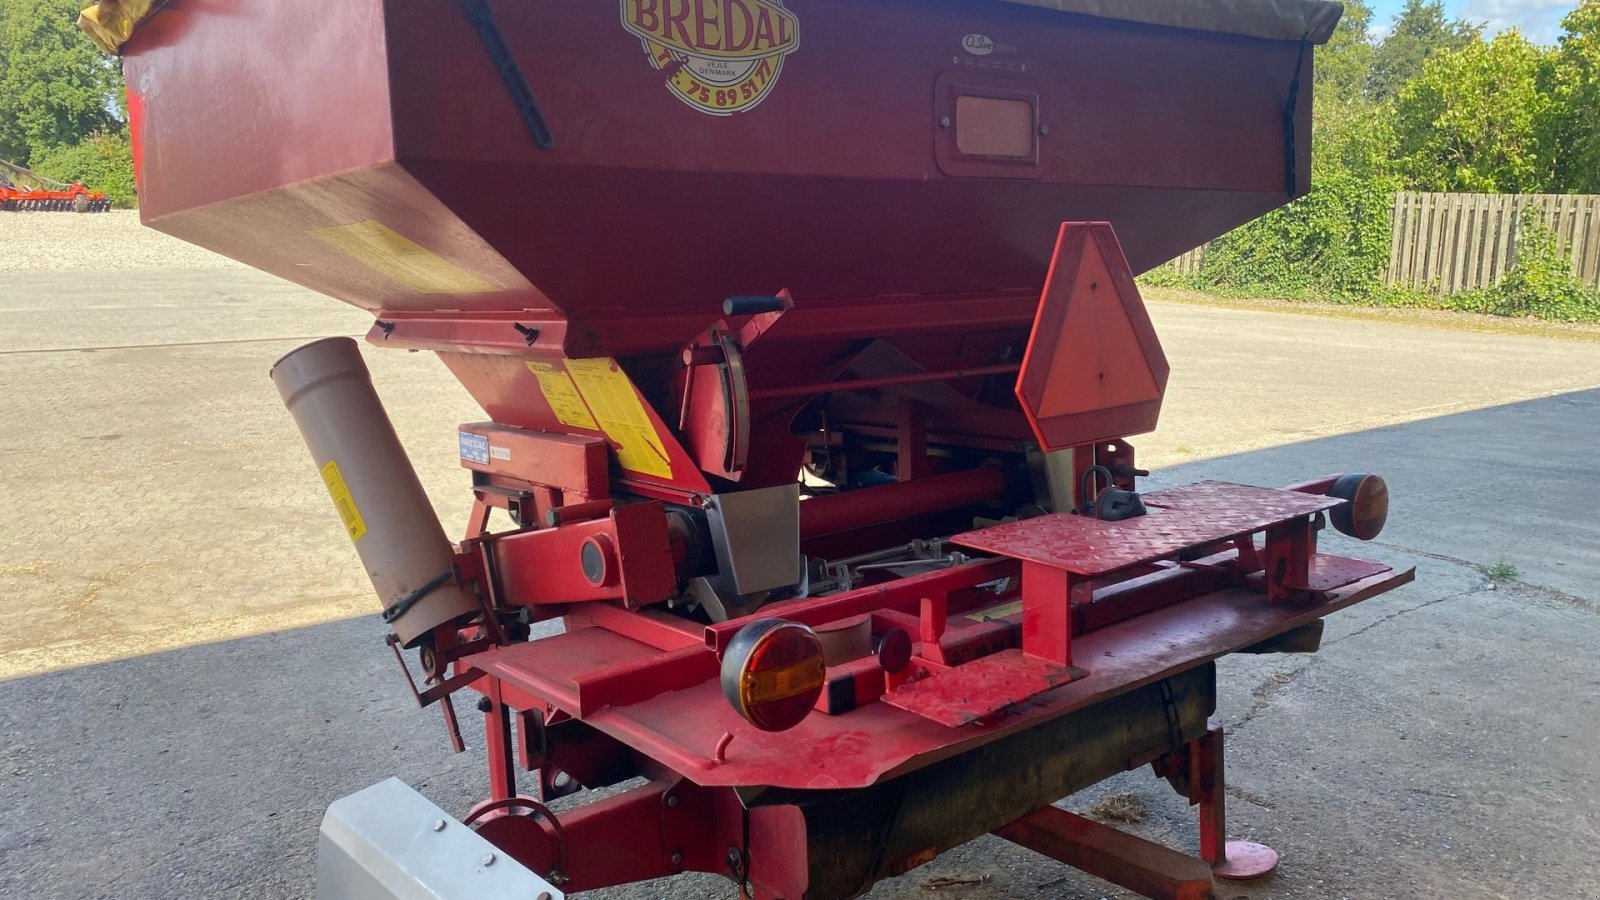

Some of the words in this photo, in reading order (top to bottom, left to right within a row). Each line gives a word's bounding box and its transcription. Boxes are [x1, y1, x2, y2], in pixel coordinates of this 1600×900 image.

[632, 0, 791, 51] BREDAL
[699, 68, 736, 77] DENMARK
[706, 61, 728, 69] VEJLE
[686, 80, 710, 103] 75
[715, 89, 737, 107] 89
[740, 82, 758, 100] 51
[755, 60, 771, 85] 77
